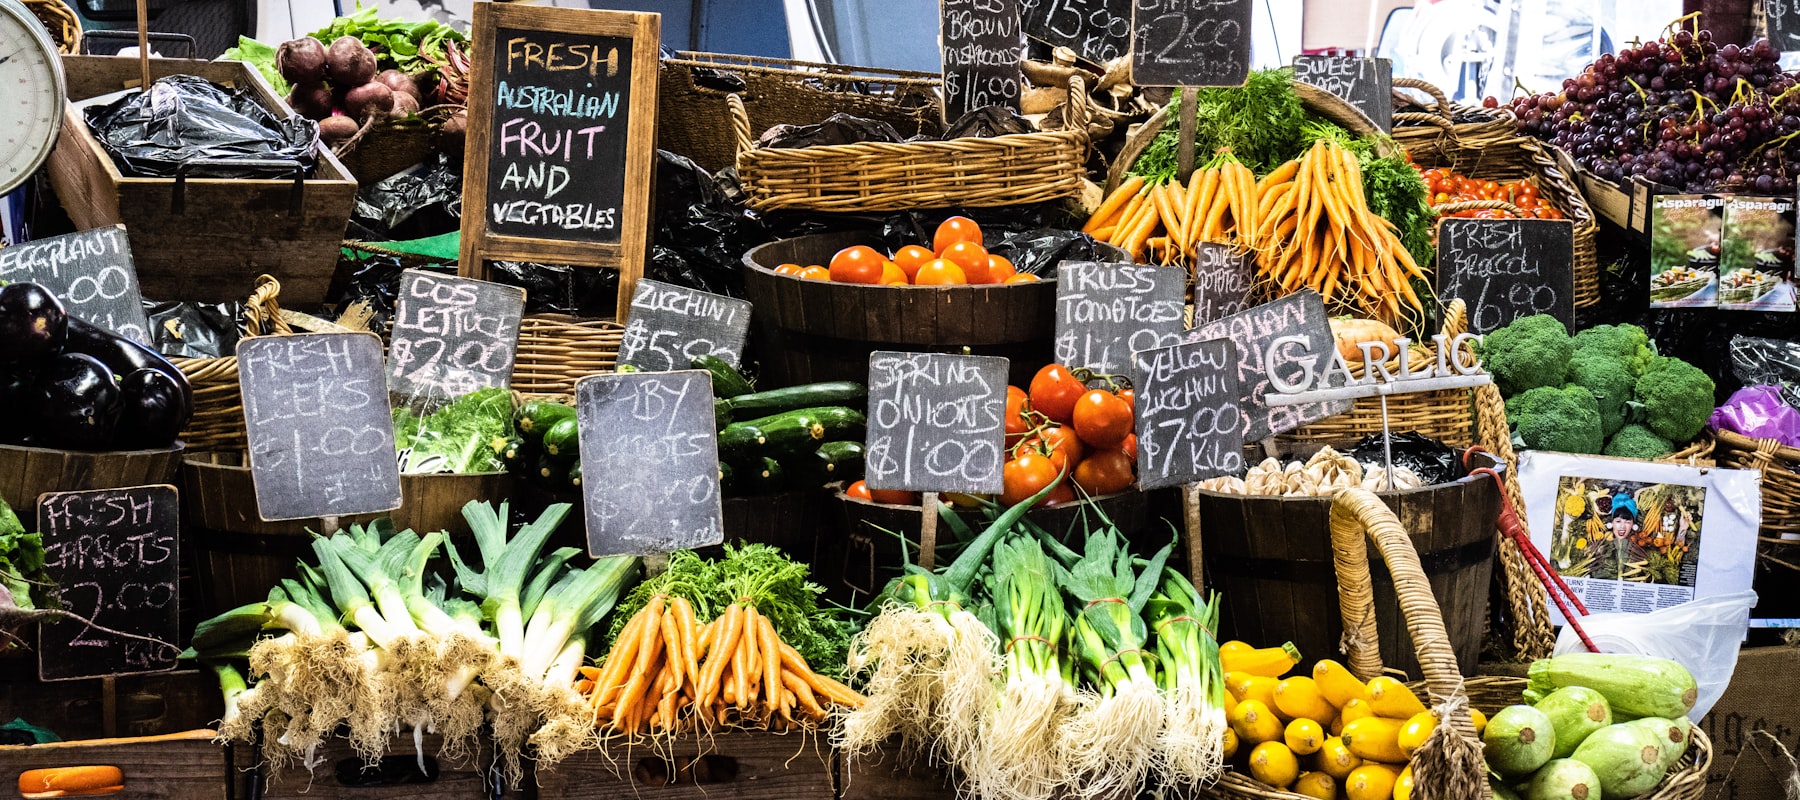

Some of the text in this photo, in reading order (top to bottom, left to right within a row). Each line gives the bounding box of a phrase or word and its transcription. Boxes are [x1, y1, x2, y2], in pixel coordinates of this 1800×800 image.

[507, 37, 619, 77] FRESH
[1293, 57, 1364, 80] SWEET
[501, 118, 606, 162] FRUIT
[500, 161, 571, 199] AND
[493, 200, 615, 231] VEGTABLES
[1448, 221, 1523, 250] FRESH
[411, 276, 478, 306] COS
[1060, 262, 1156, 293] TRUSS
[397, 300, 518, 341] LETTUCE
[393, 337, 513, 384] $2.00
[877, 395, 1003, 434] ONIONS
[868, 424, 999, 486] $1.00
[1140, 402, 1239, 478] $7.00
[43, 494, 153, 536] FRESH
